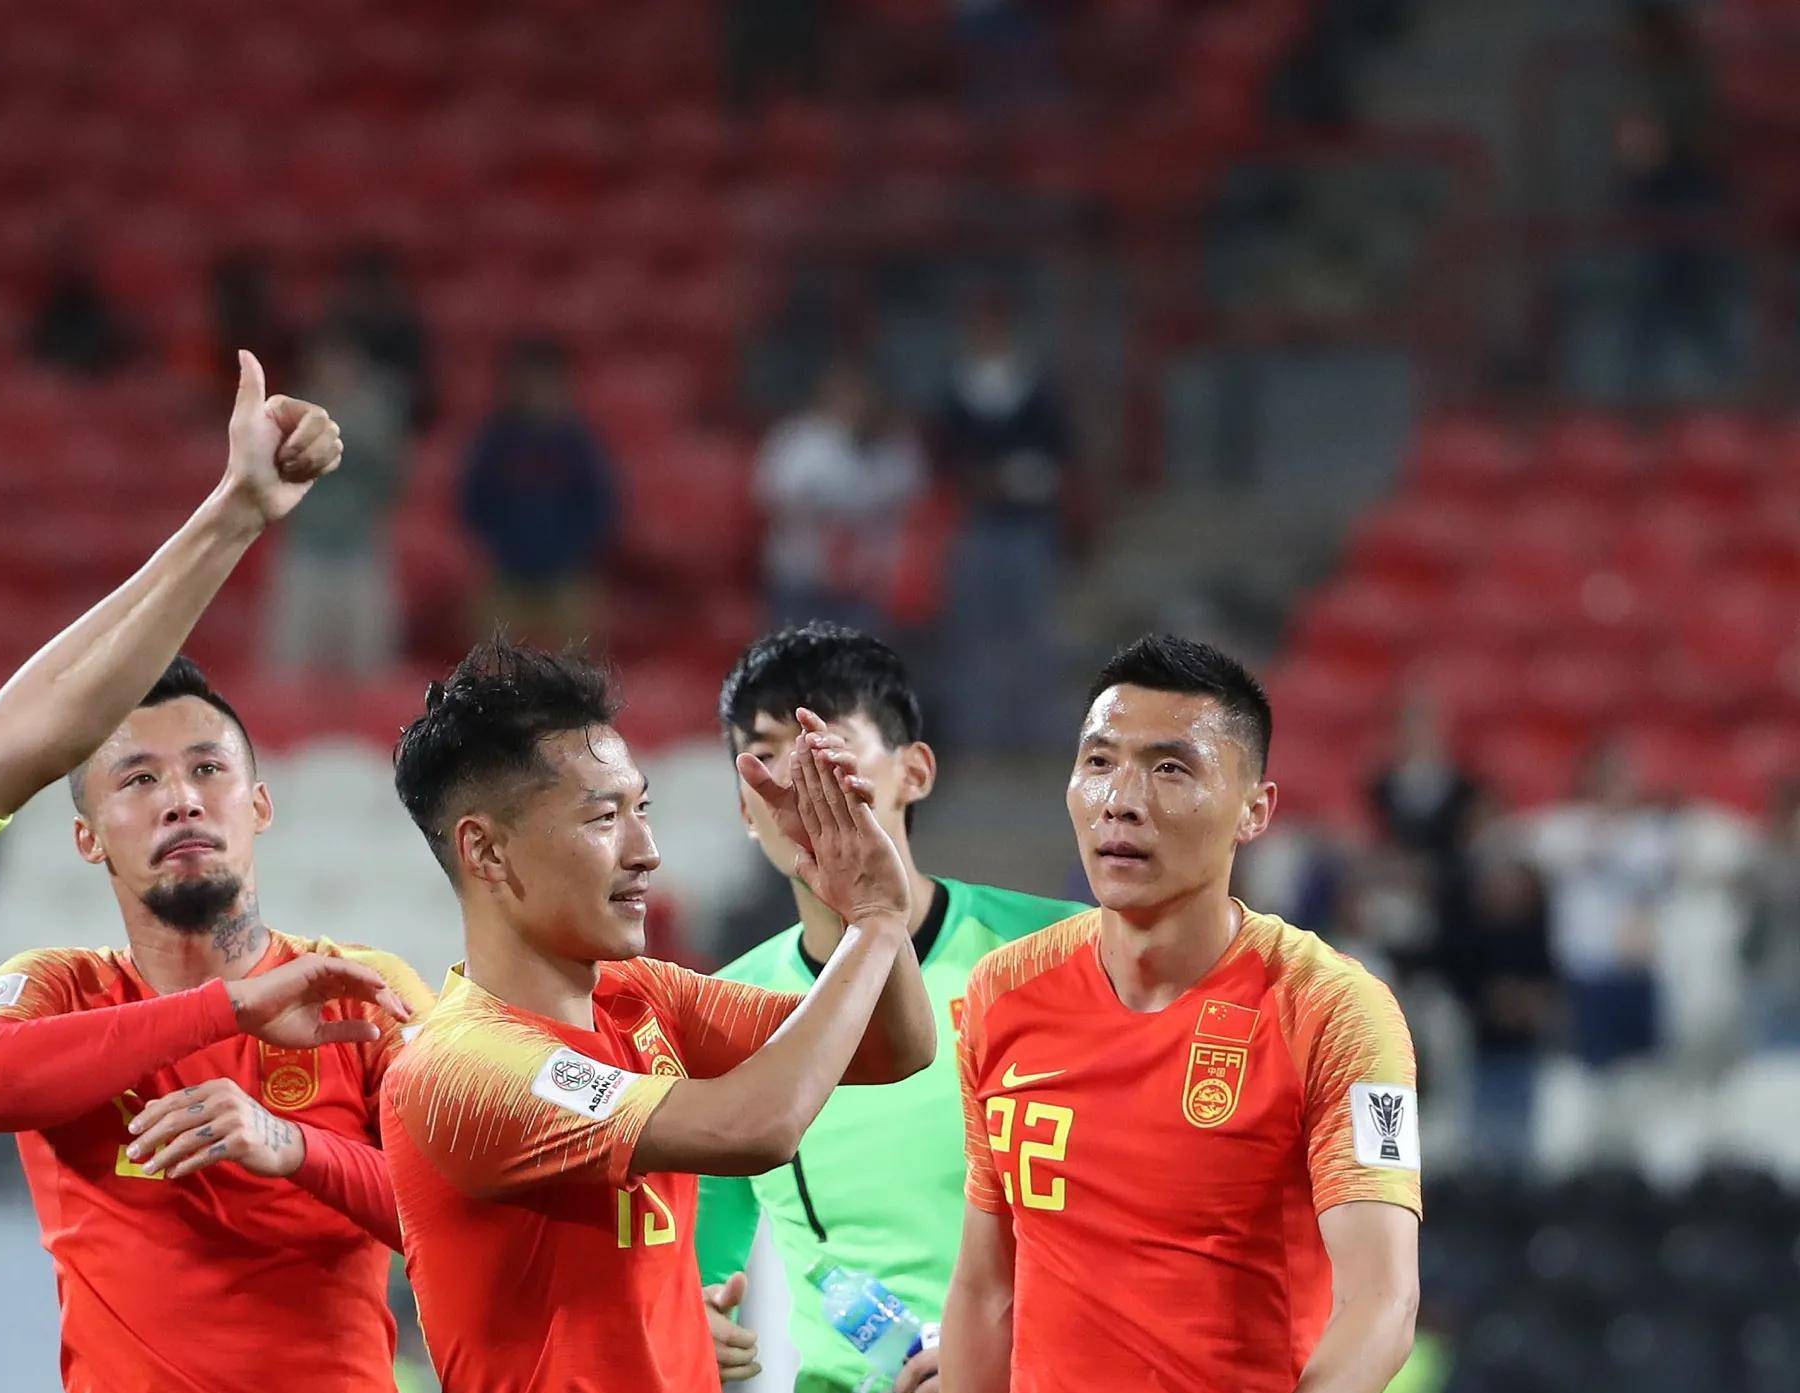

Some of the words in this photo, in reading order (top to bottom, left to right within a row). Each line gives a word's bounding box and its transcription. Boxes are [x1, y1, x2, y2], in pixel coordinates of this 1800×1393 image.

[1195, 1049, 1242, 1068] CFA
[591, 1074, 605, 1090] AFC
[589, 1081, 611, 1112] ASIAN
[986, 1096, 1074, 1211] 22
